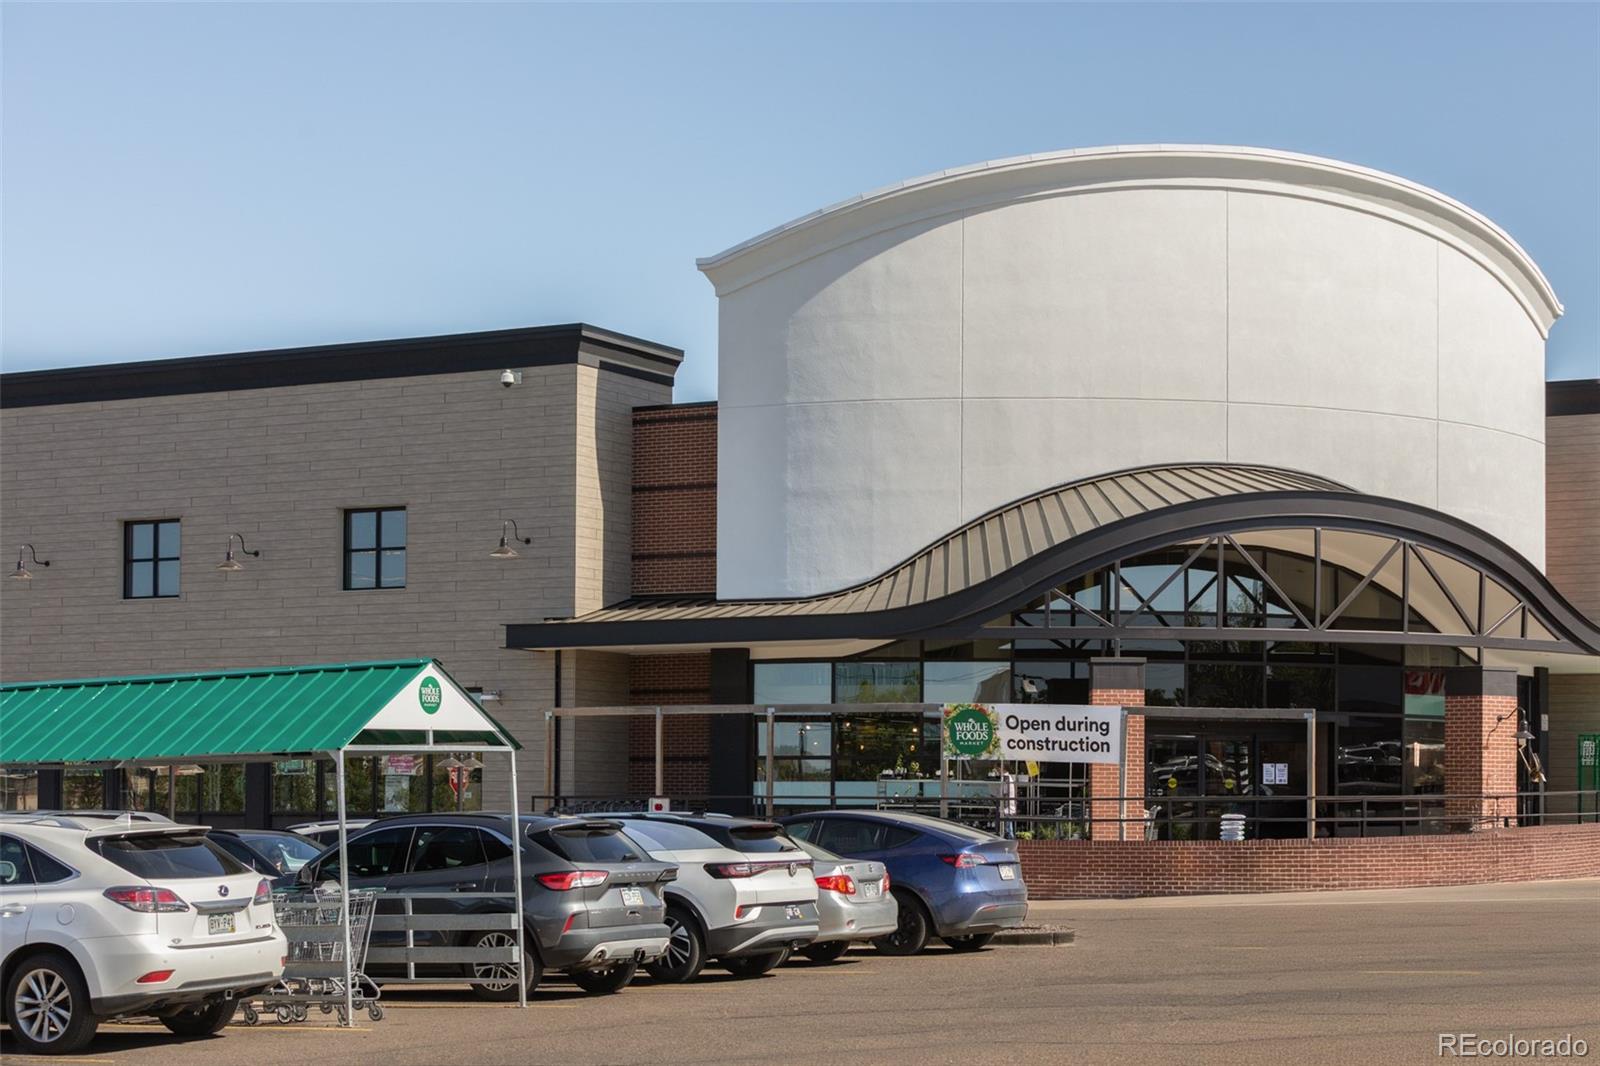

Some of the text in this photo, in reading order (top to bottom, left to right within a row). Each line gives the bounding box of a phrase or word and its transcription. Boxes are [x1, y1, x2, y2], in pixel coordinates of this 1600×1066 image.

[421, 694, 440, 703] FOODS
[954, 720, 989, 732] WHOLE
[1005, 714, 1110, 736] Open during
[955, 731, 989, 741] FOODS
[1006, 736, 1110, 753] construction
